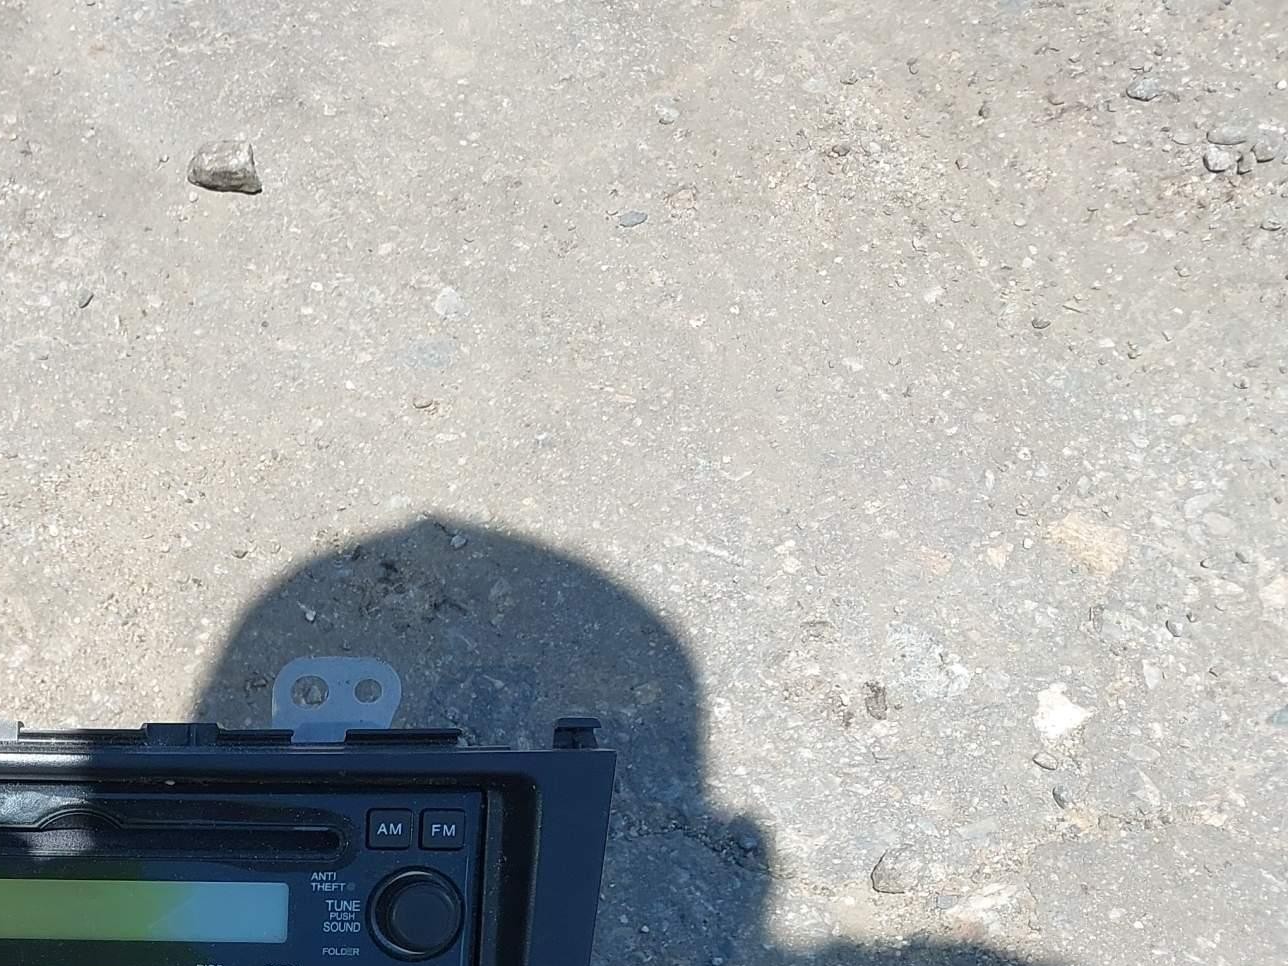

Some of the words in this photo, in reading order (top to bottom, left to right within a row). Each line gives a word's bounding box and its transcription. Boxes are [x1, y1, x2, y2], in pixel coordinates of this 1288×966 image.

[377, 823, 402, 836] AM
[431, 824, 456, 837] FM
[311, 872, 337, 881] ANTI
[311, 882, 346, 892] THEFT
[325, 900, 361, 912] TUNE
[329, 911, 356, 921] PUSH
[322, 921, 361, 933] SOUND
[322, 947, 360, 956] FOLDER
